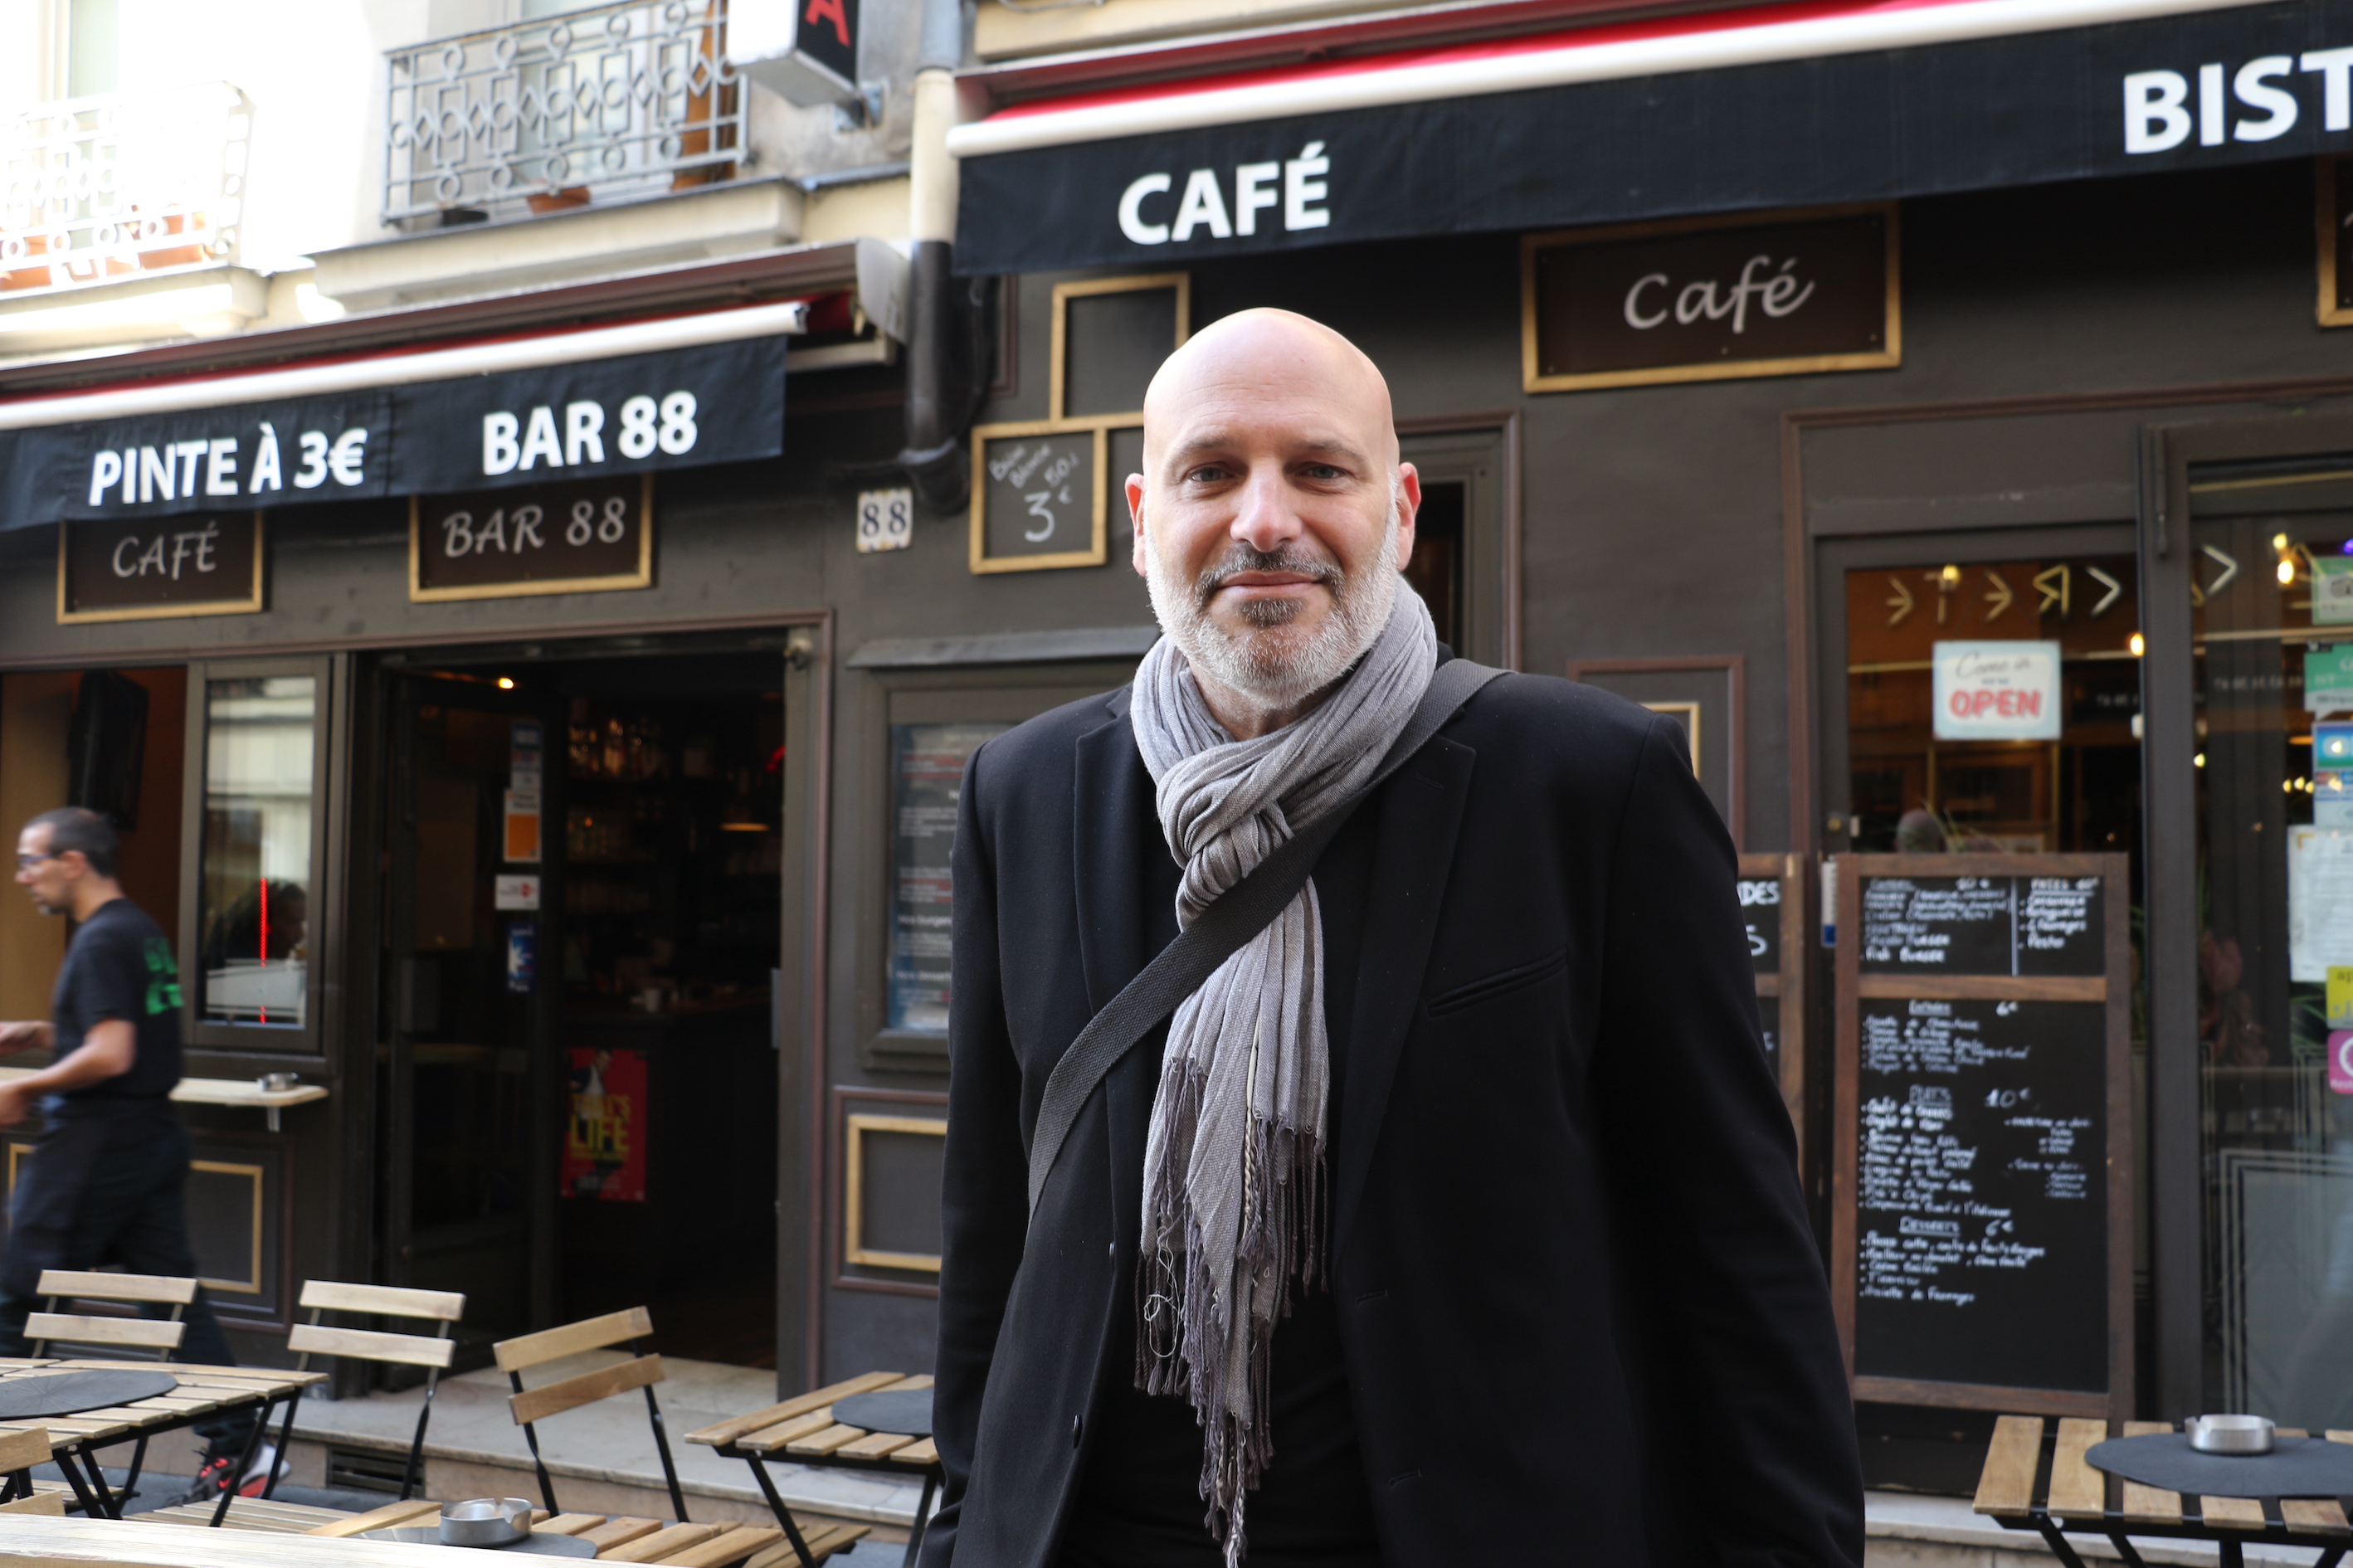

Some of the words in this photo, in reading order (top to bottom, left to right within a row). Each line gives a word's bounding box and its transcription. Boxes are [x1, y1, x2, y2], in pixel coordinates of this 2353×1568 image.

[1118, 141, 1331, 246] CAFÉ
[1623, 255, 1815, 334] Café
[89, 437, 239, 507] PINTE
[249, 421, 282, 494] À
[294, 427, 369, 489] 3€
[482, 401, 606, 476] BAR
[617, 390, 699, 460] 88
[112, 521, 221, 581] CAFÉ
[442, 504, 546, 559] BAR
[566, 498, 628, 548] 88
[863, 500, 906, 538] 88
[1950, 689, 2042, 718] OPEN
